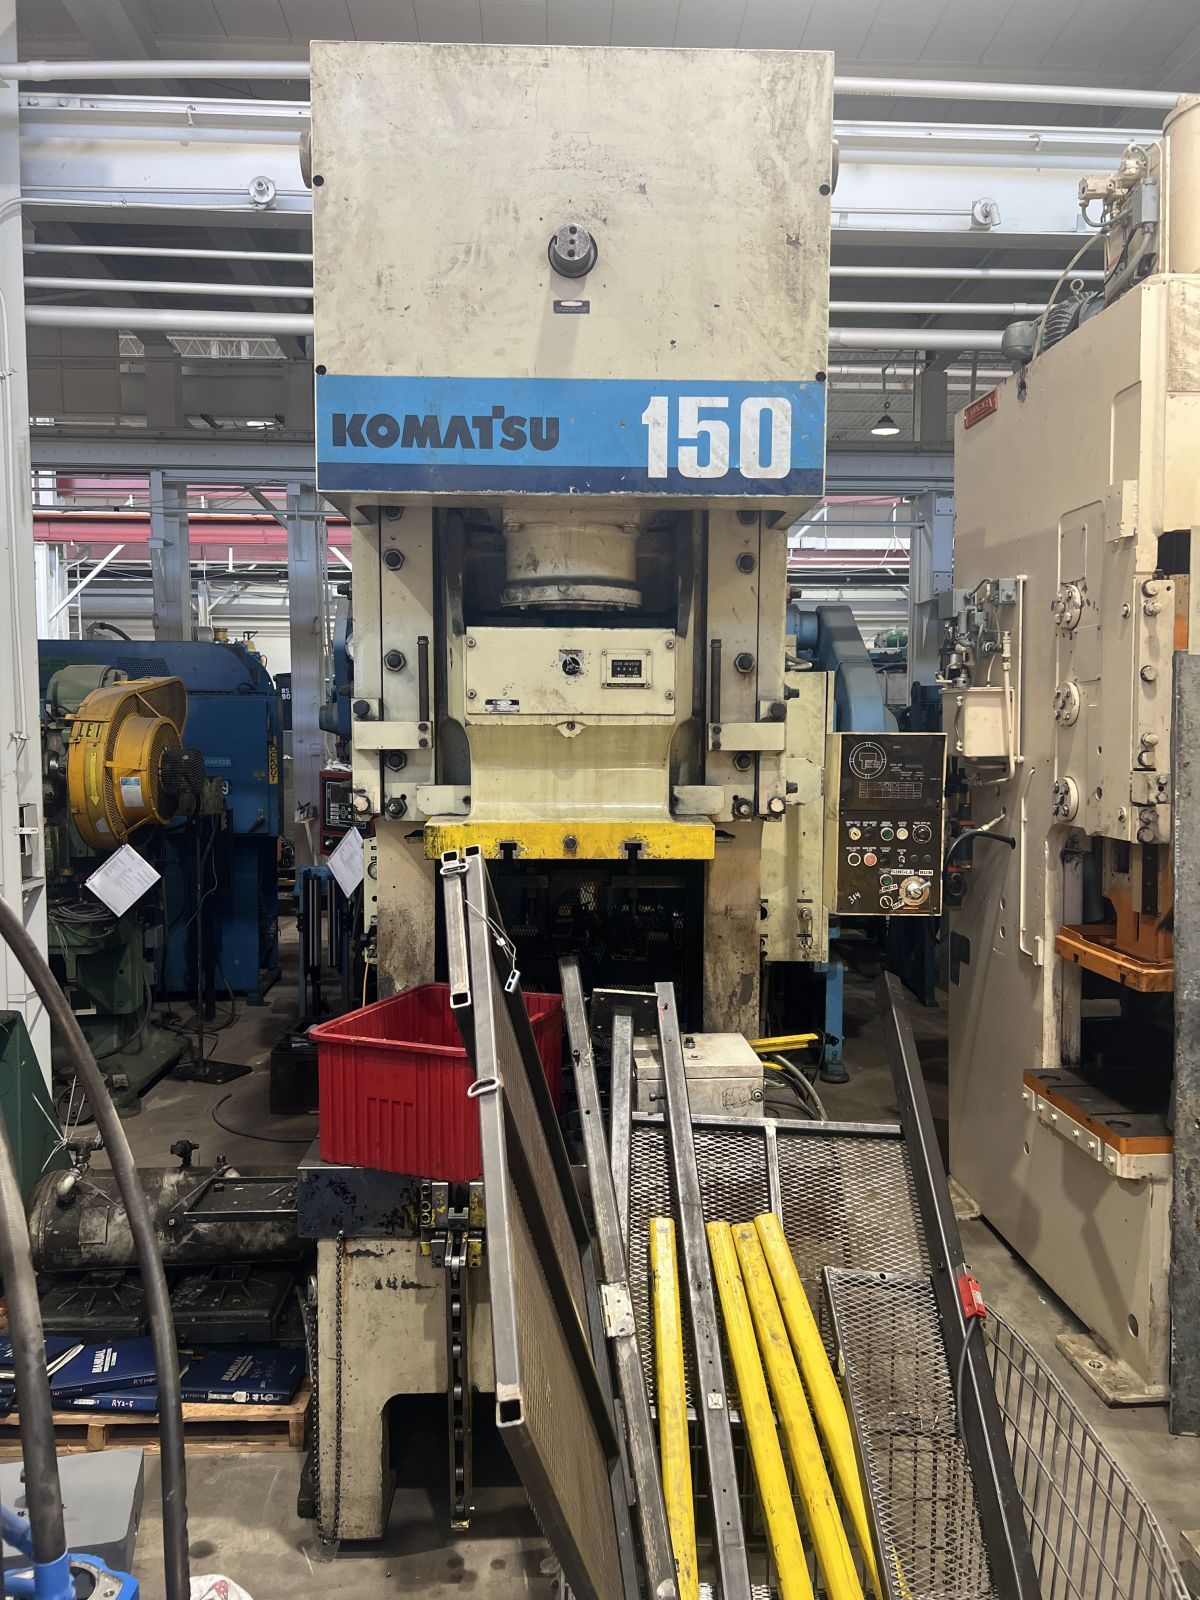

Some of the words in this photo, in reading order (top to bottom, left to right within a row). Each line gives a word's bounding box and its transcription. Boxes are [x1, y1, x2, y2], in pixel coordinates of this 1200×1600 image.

[333, 405, 560, 451] KOMATSU
[641, 395, 792, 479] 150
[220, 1355, 247, 1381] MANUAL
